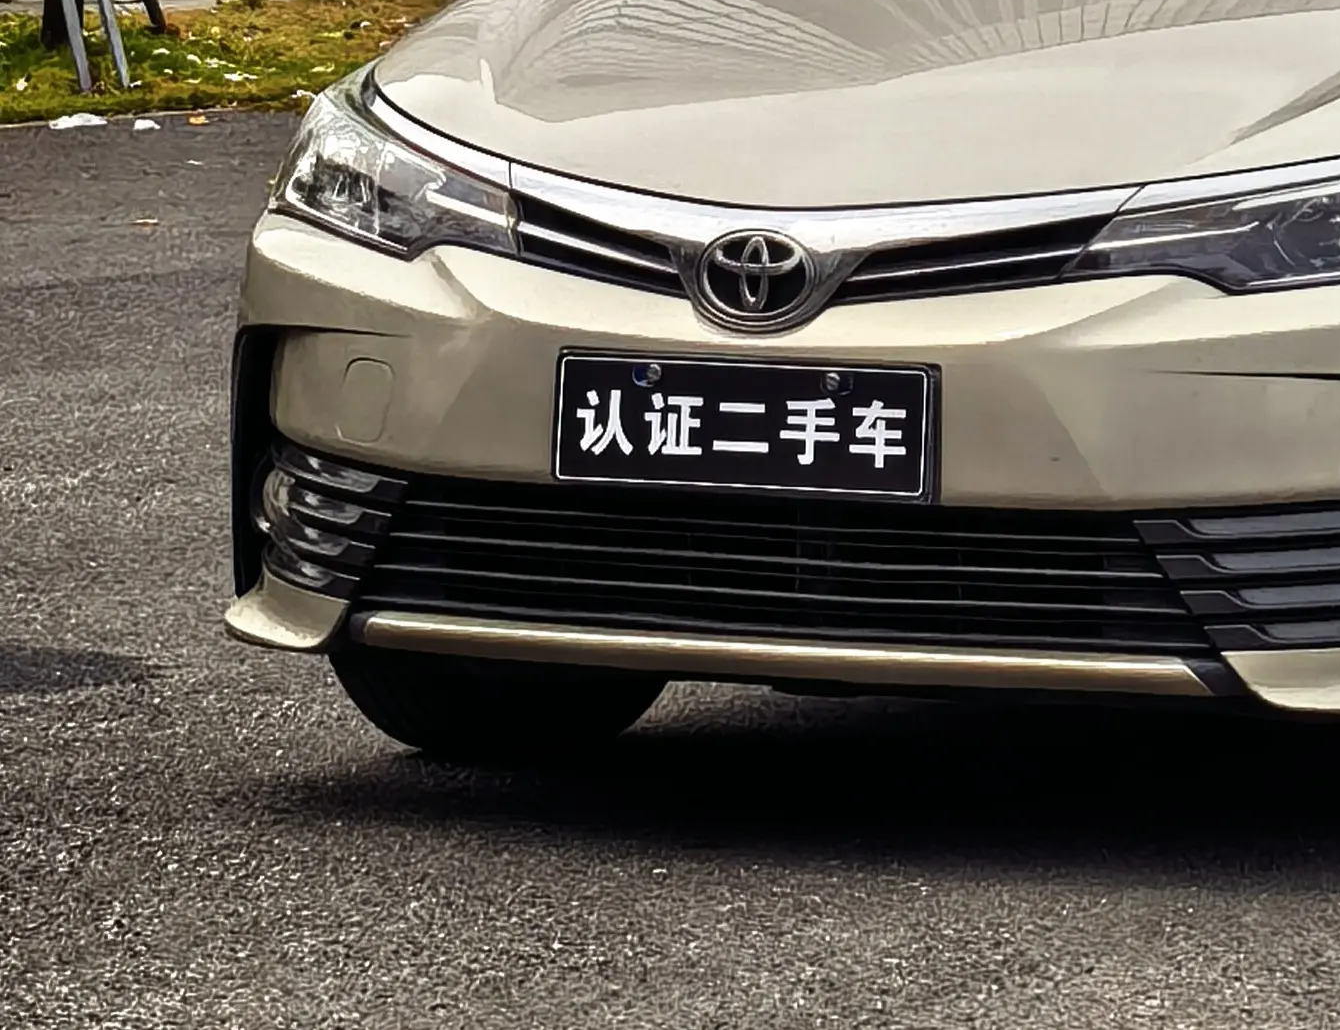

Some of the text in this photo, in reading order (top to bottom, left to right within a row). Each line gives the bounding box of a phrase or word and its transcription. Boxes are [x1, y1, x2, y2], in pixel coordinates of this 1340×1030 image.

[576, 389, 907, 468] 认证二手车
